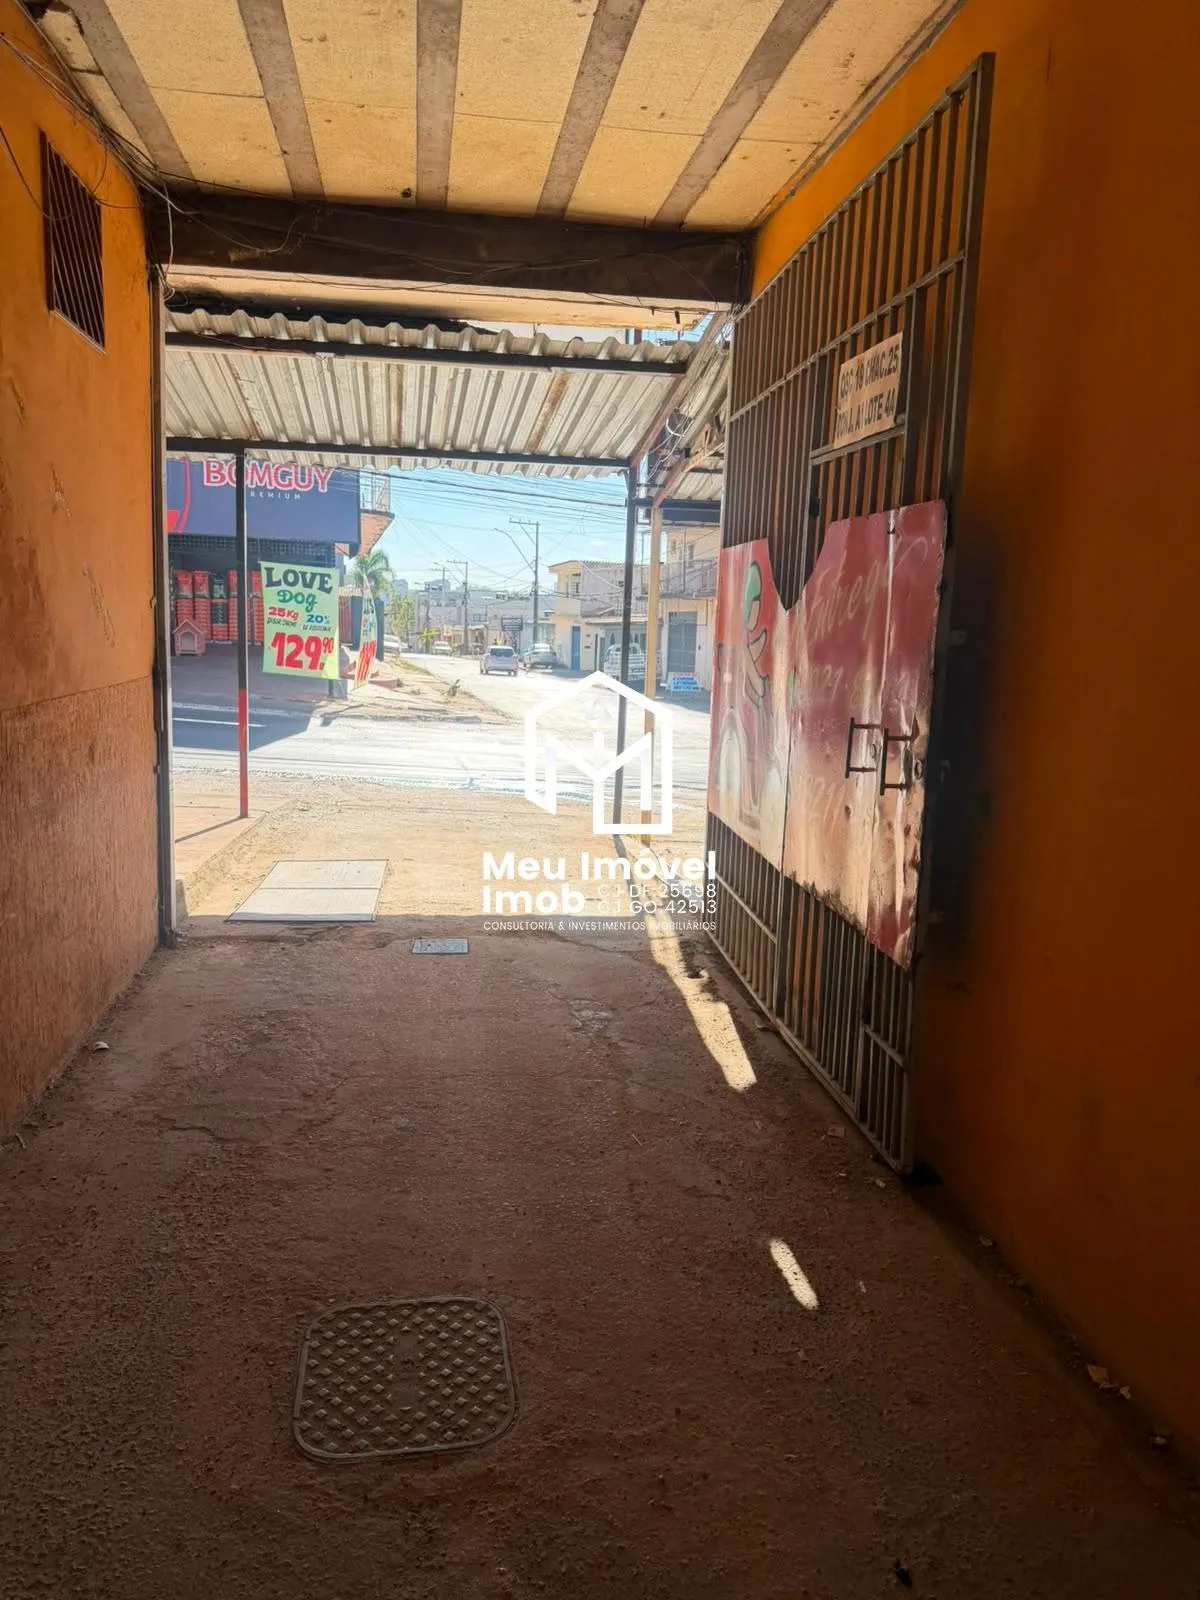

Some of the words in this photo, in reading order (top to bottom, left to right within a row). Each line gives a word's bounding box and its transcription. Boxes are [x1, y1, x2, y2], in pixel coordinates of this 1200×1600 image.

[203, 459, 334, 493] BOMGUY
[250, 491, 301, 500] REMIUM
[264, 567, 333, 594] LOVE
